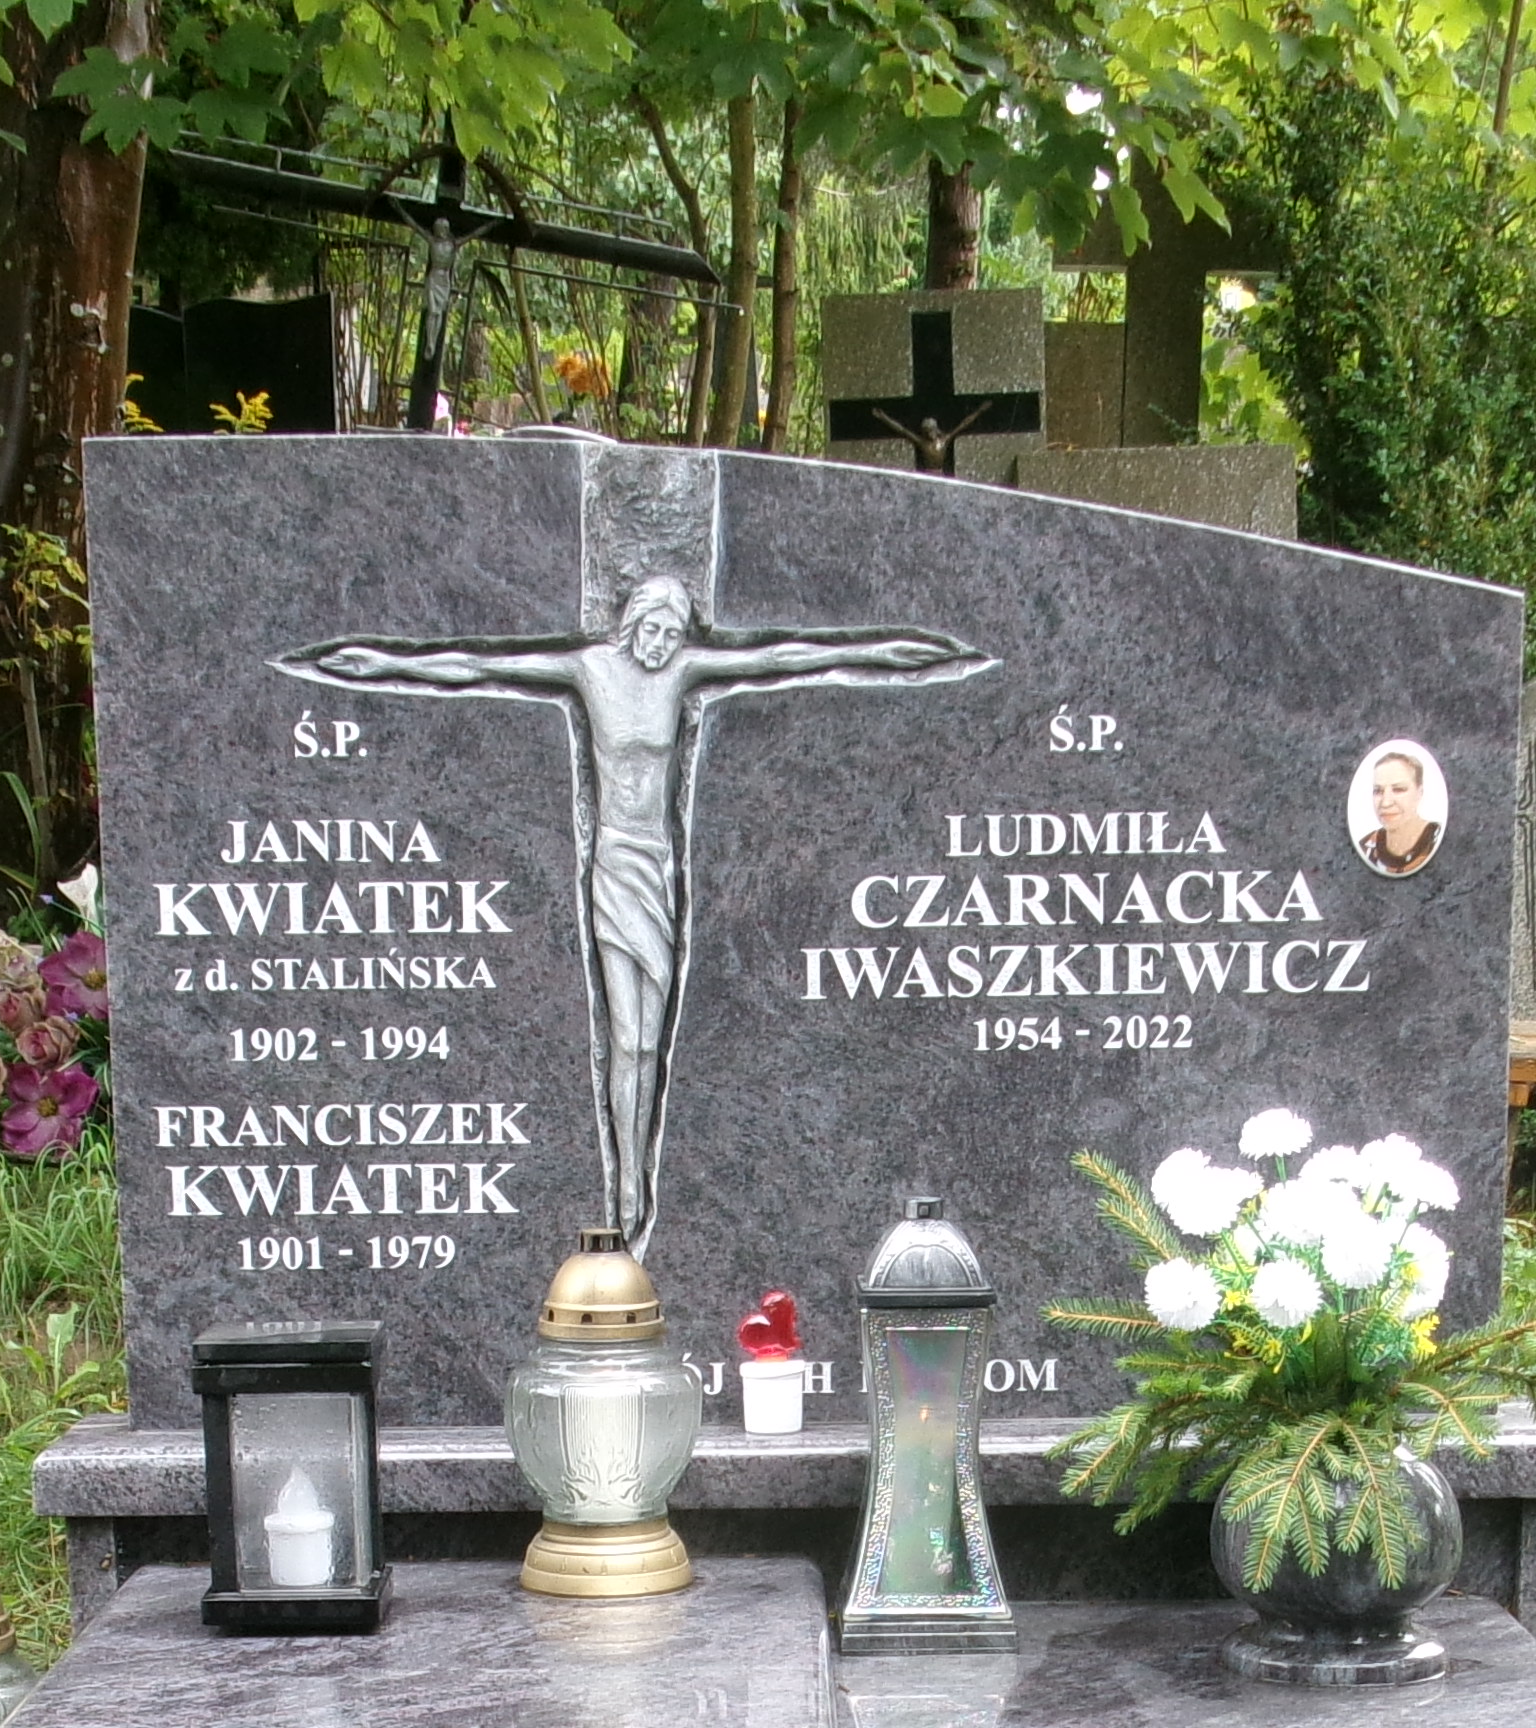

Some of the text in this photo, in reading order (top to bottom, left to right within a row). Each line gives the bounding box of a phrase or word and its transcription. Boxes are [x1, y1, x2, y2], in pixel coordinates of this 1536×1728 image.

[293, 709, 368, 759] Ś.P.
[1049, 703, 1124, 753] Ś.P.
[220, 818, 442, 864] JANINA
[944, 810, 1228, 857] LUDMIŁA
[152, 880, 514, 937] KWIATEK
[850, 869, 1325, 929] CZARNACKA
[174, 946, 497, 992] z d. STALIŃSKA
[800, 938, 1370, 1001] IWASZKIEWICZ
[229, 1027, 318, 1062] 1902
[360, 1025, 451, 1061] 1994
[973, 1016, 1063, 1052] 1954
[1102, 1014, 1194, 1050] 2022
[152, 1102, 532, 1148] FRANCISZEK
[164, 1162, 520, 1217] KWIATEK
[237, 1235, 324, 1271] 1901
[367, 1234, 456, 1269] 1979
